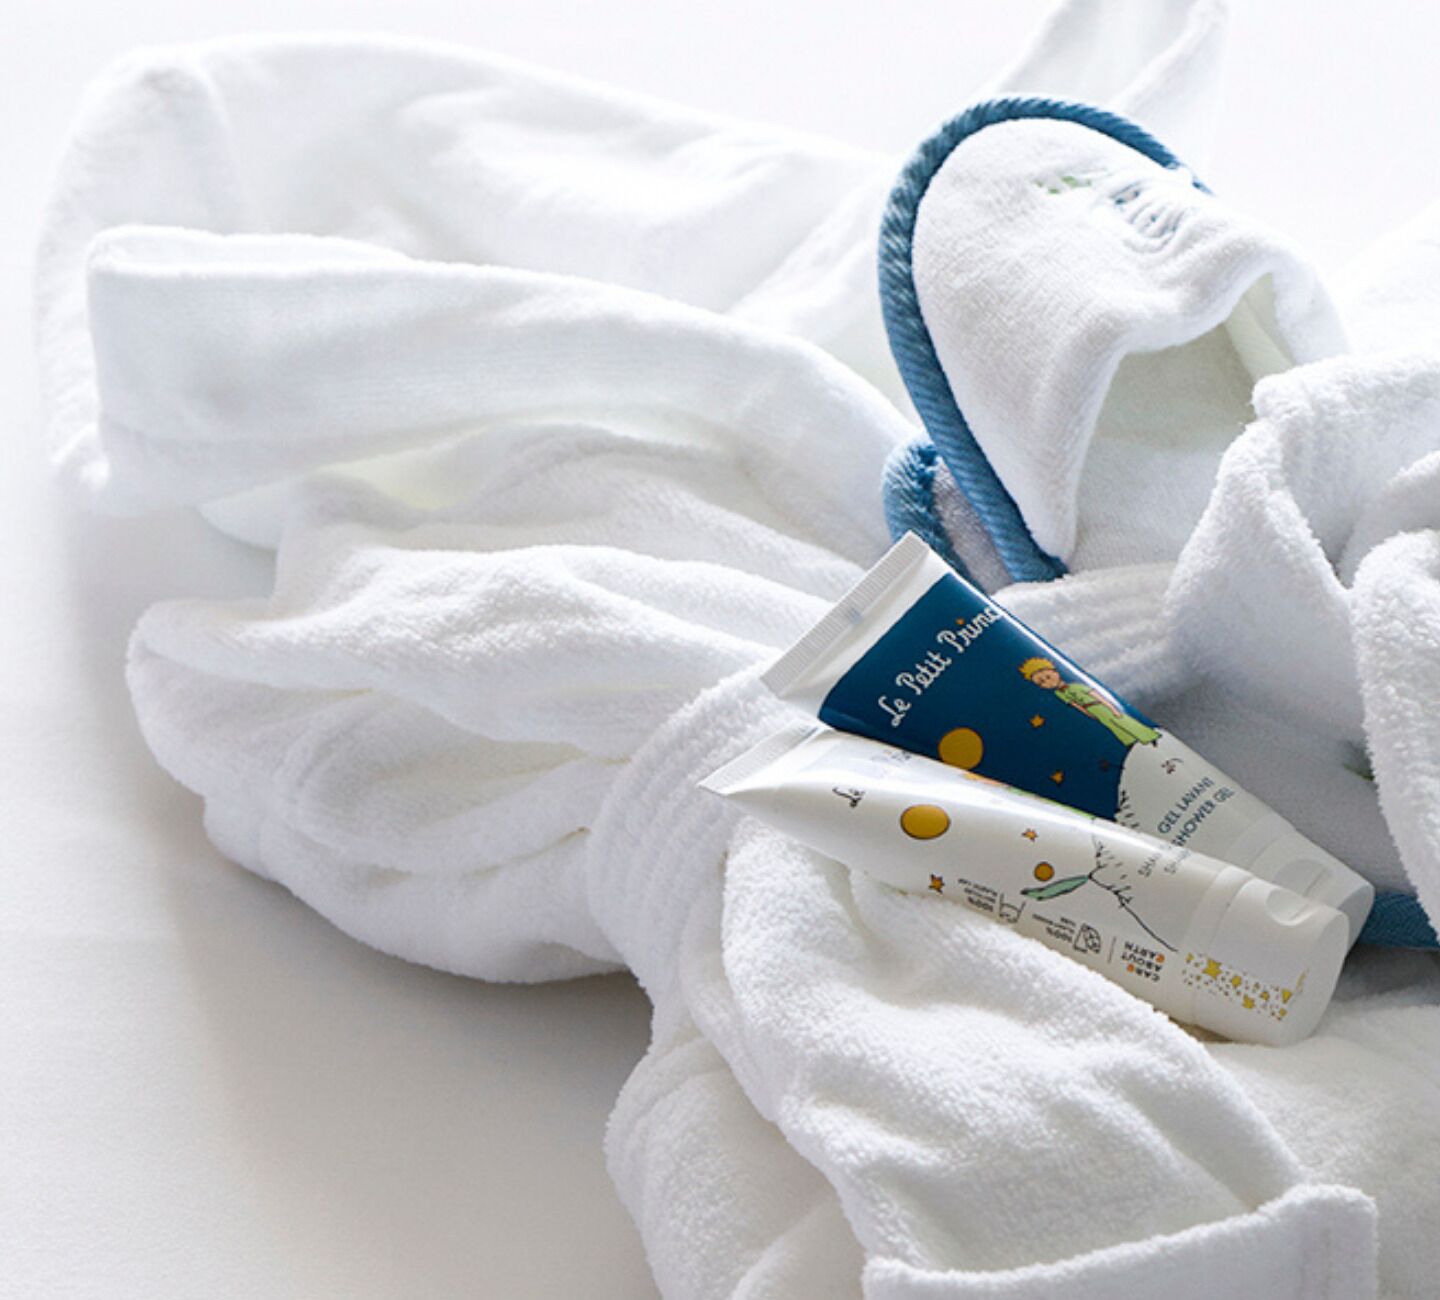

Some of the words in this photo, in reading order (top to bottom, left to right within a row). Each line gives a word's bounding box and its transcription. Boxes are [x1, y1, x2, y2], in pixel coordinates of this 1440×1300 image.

[878, 695, 912, 728] Le
[895, 651, 952, 695] Petit
[1157, 810, 1183, 834] GEL
